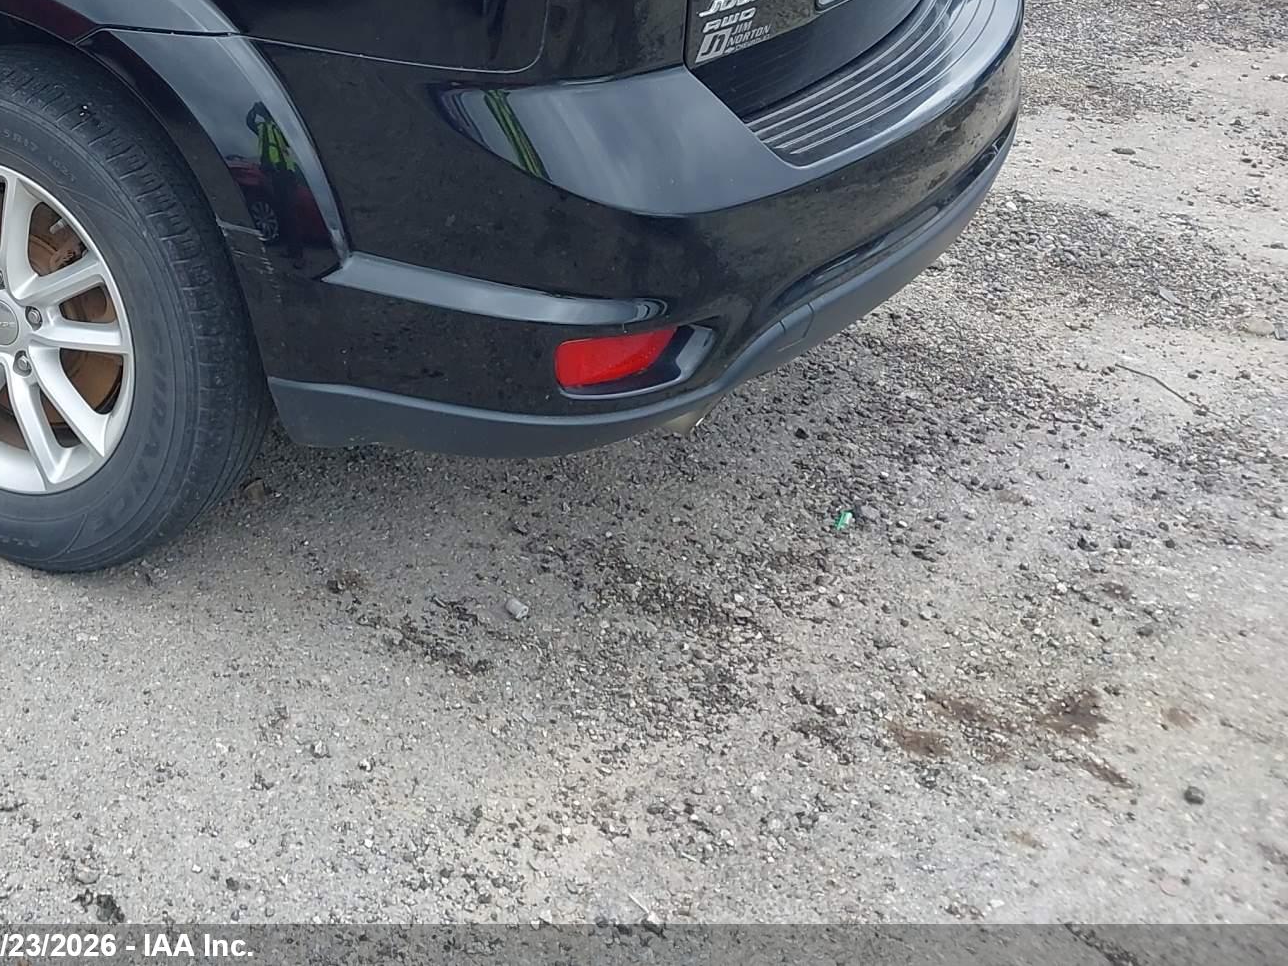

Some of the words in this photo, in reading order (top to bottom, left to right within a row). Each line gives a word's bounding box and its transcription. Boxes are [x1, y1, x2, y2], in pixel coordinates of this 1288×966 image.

[703, 7, 756, 33] AWD
[732, 20, 753, 35] JIM
[726, 24, 771, 48] NORTON
